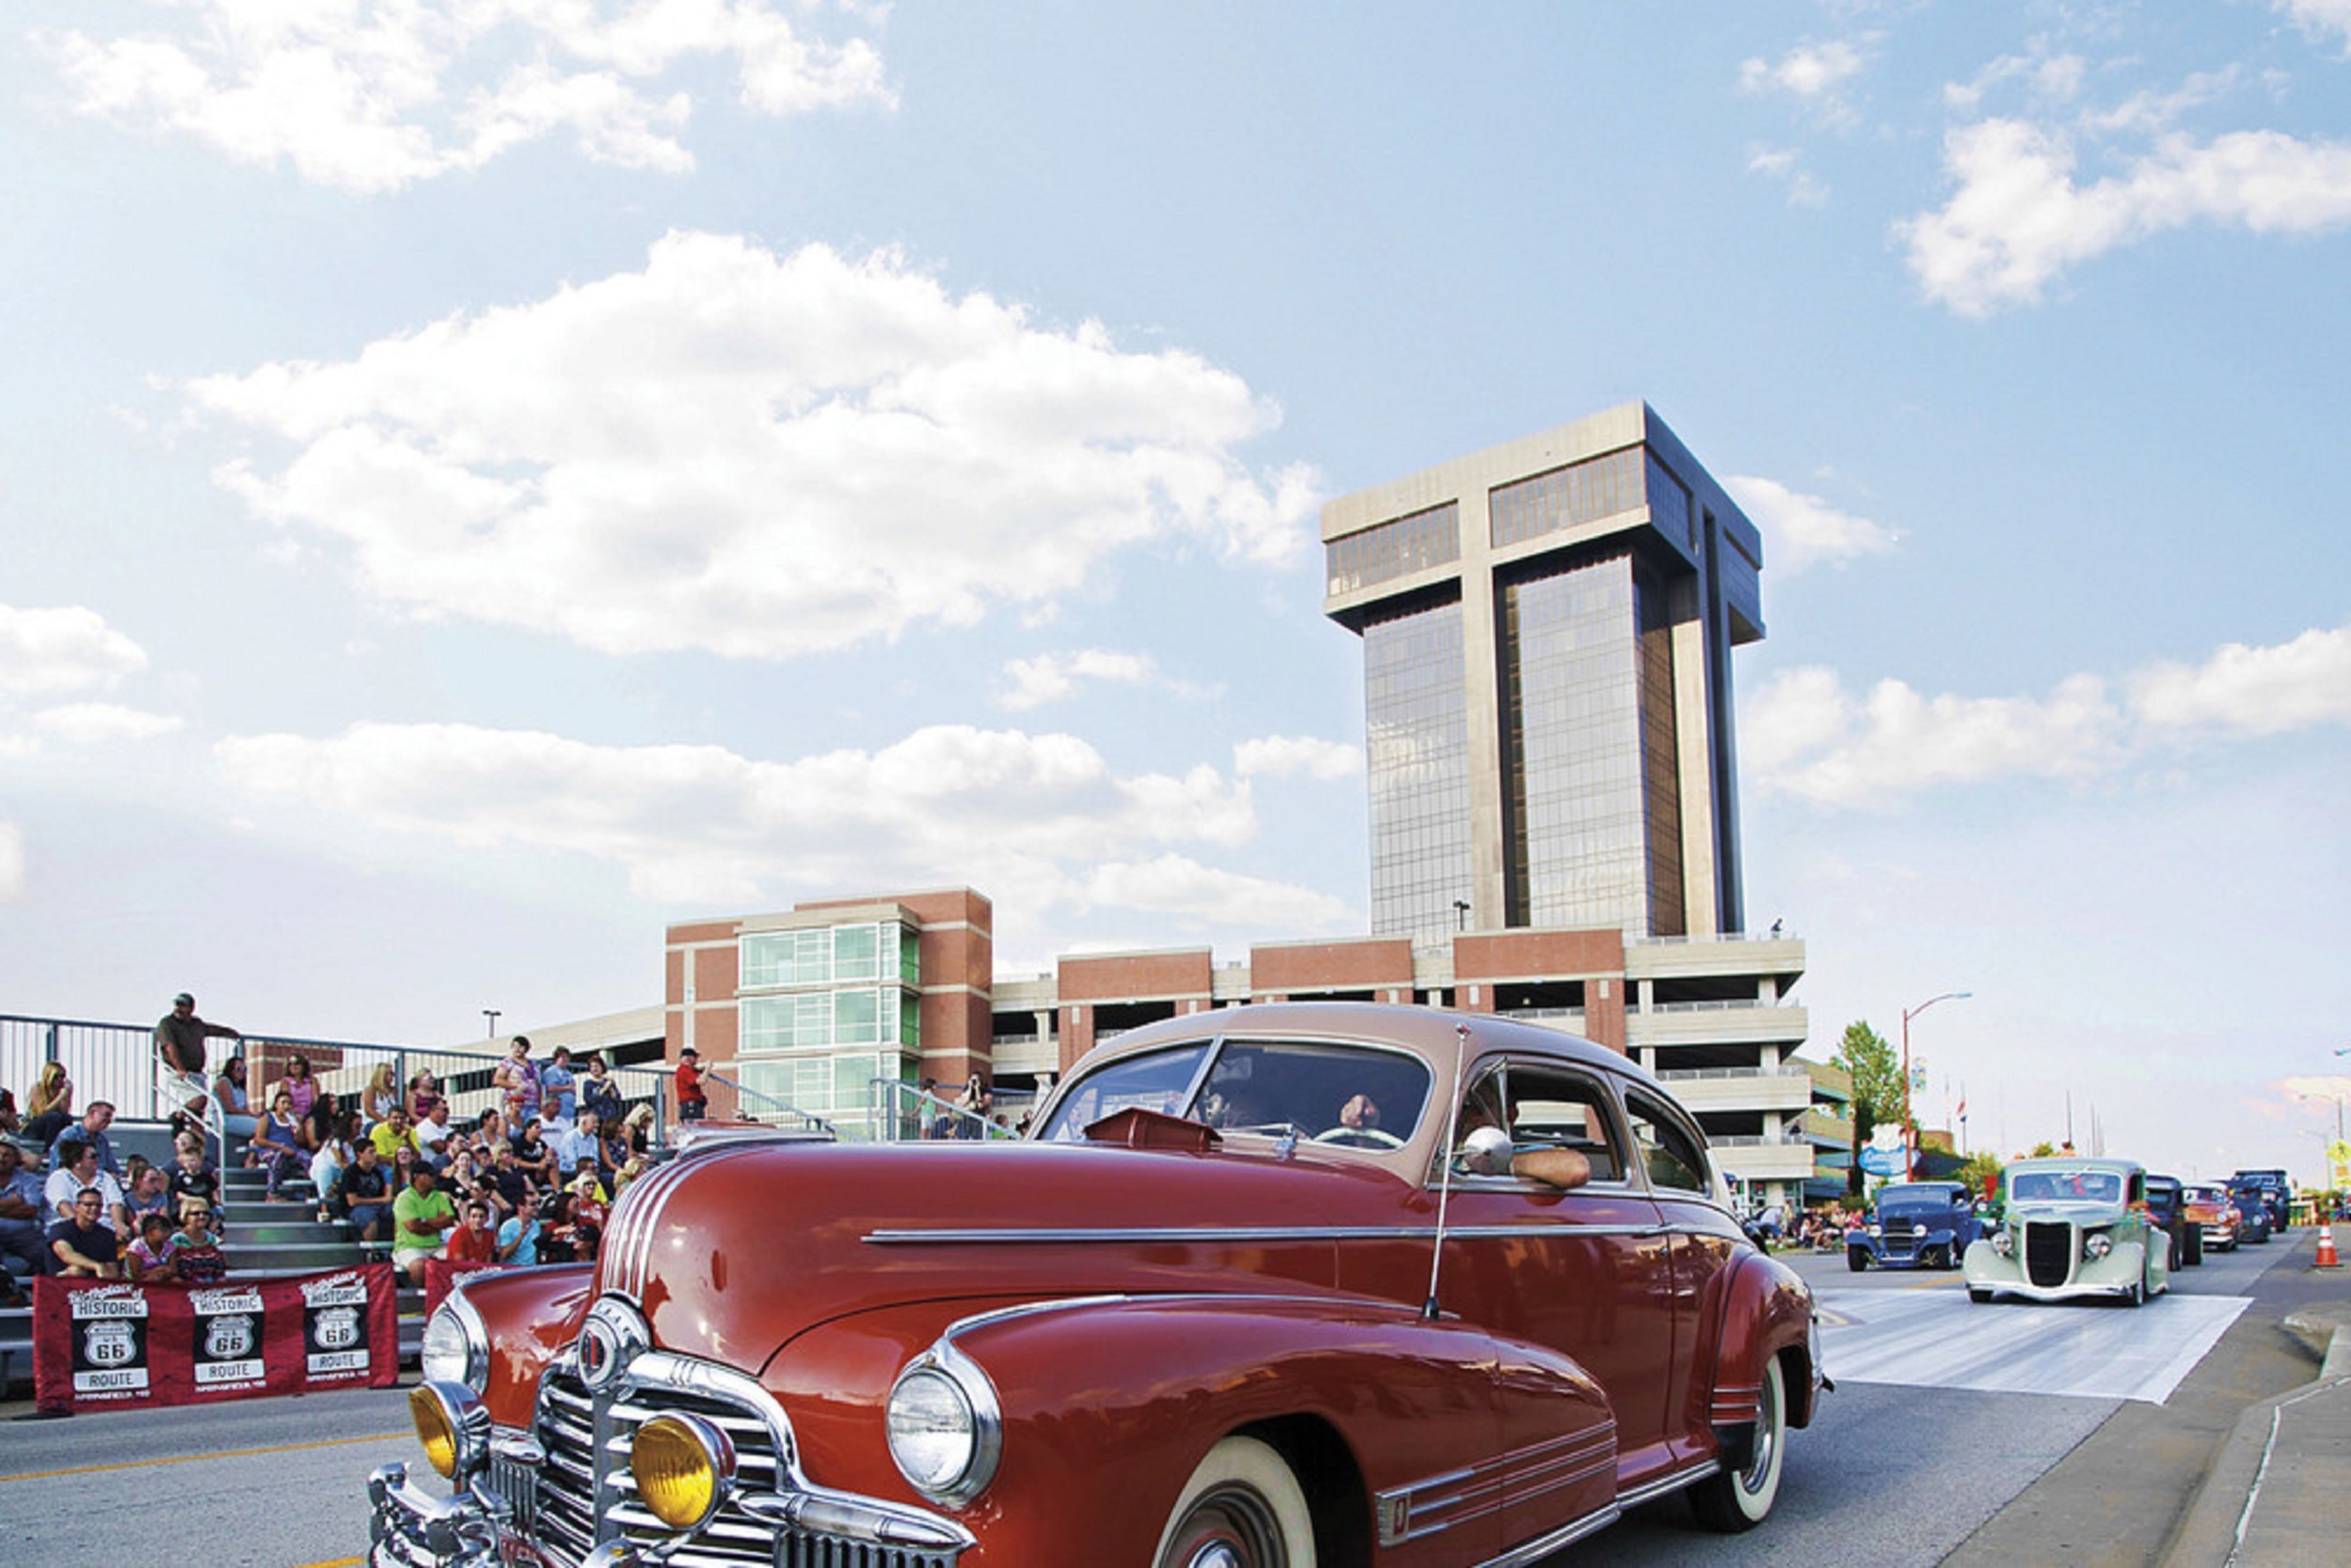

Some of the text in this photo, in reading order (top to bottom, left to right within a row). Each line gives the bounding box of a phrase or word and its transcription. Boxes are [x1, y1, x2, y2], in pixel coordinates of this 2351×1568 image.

[200, 1297, 257, 1311] HISTORIC
[312, 1289, 361, 1304] HISTORIC
[79, 1302, 142, 1315] HISTORIC
[326, 1327, 350, 1343] 66
[97, 1345, 125, 1359] 66
[216, 1337, 242, 1352] 66
[319, 1353, 356, 1368] ROUTE
[209, 1363, 250, 1378] ROUTE
[89, 1373, 134, 1387] ROUTE
